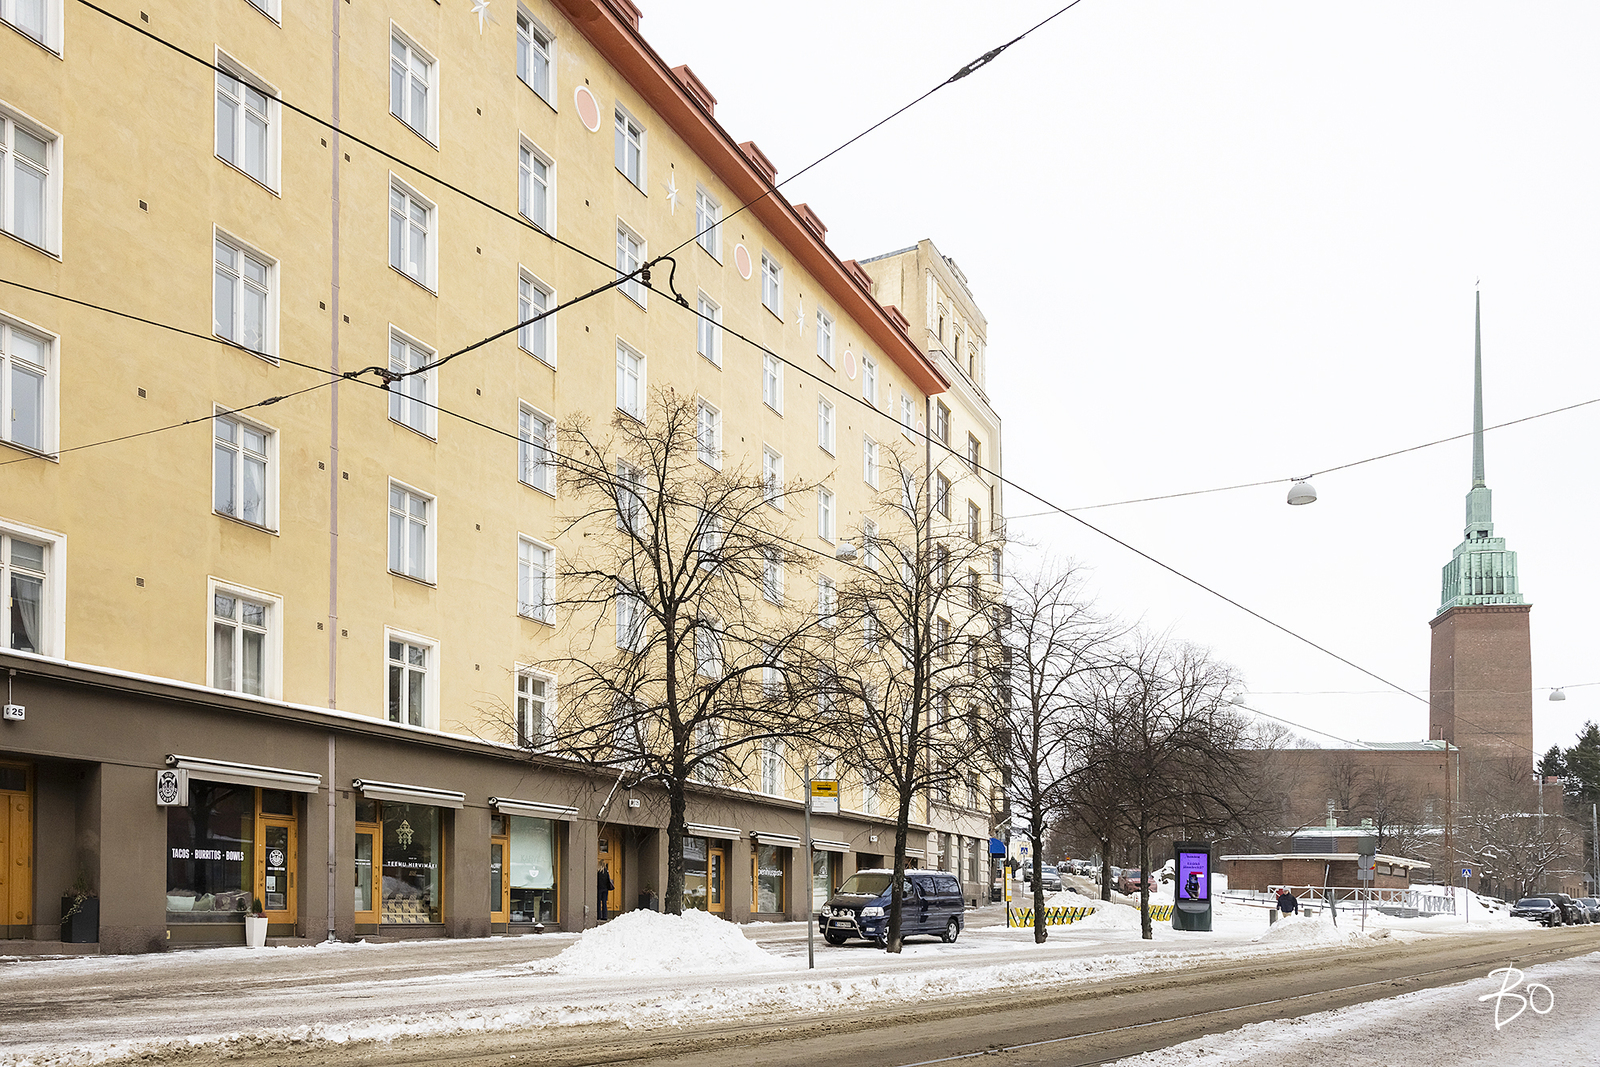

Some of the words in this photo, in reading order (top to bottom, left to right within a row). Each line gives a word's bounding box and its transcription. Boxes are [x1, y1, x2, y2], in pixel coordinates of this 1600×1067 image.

[12, 708, 23, 716] 25
[172, 848, 189, 859] TACOS
[195, 849, 221, 860] BURRITOS
[226, 851, 244, 861] BOWLS
